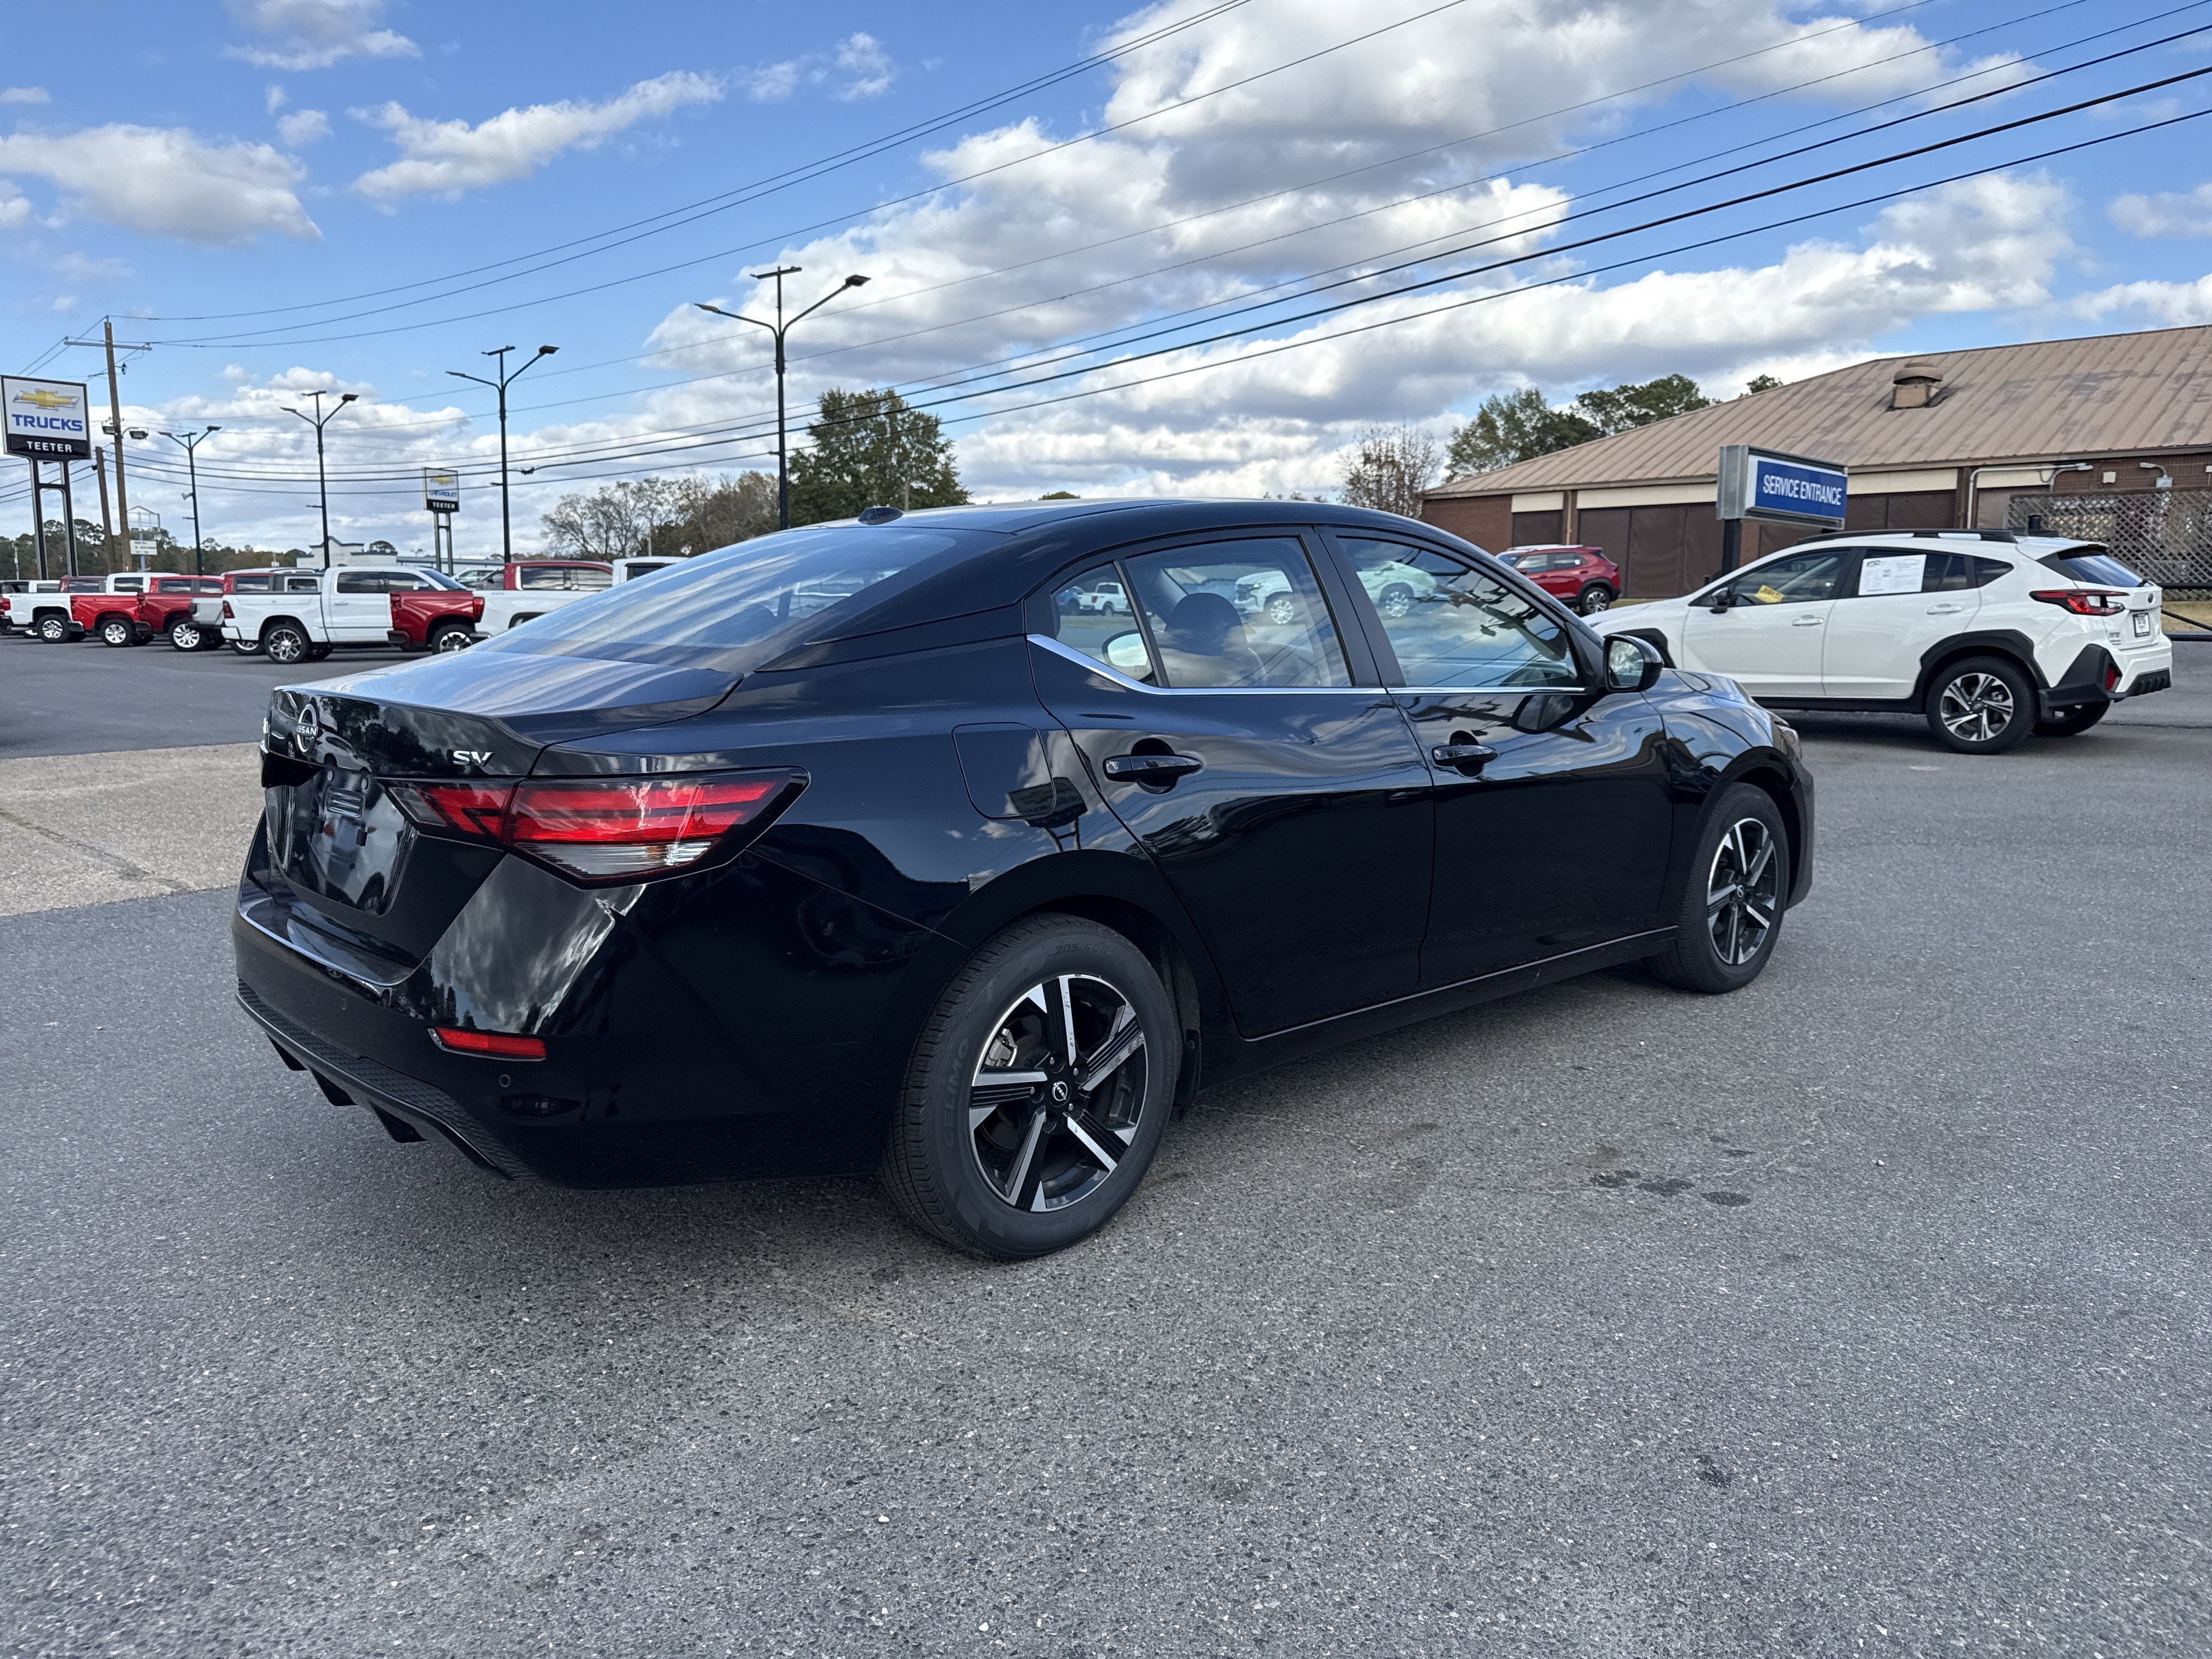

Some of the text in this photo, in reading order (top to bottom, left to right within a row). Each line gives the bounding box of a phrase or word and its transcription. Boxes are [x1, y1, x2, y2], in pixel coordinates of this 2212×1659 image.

[12, 414, 83, 432] TRUCKS
[26, 441, 72, 453] TEETER
[1763, 474, 1842, 506] SERVICE ENTRANCE
[453, 750, 494, 766] SV
